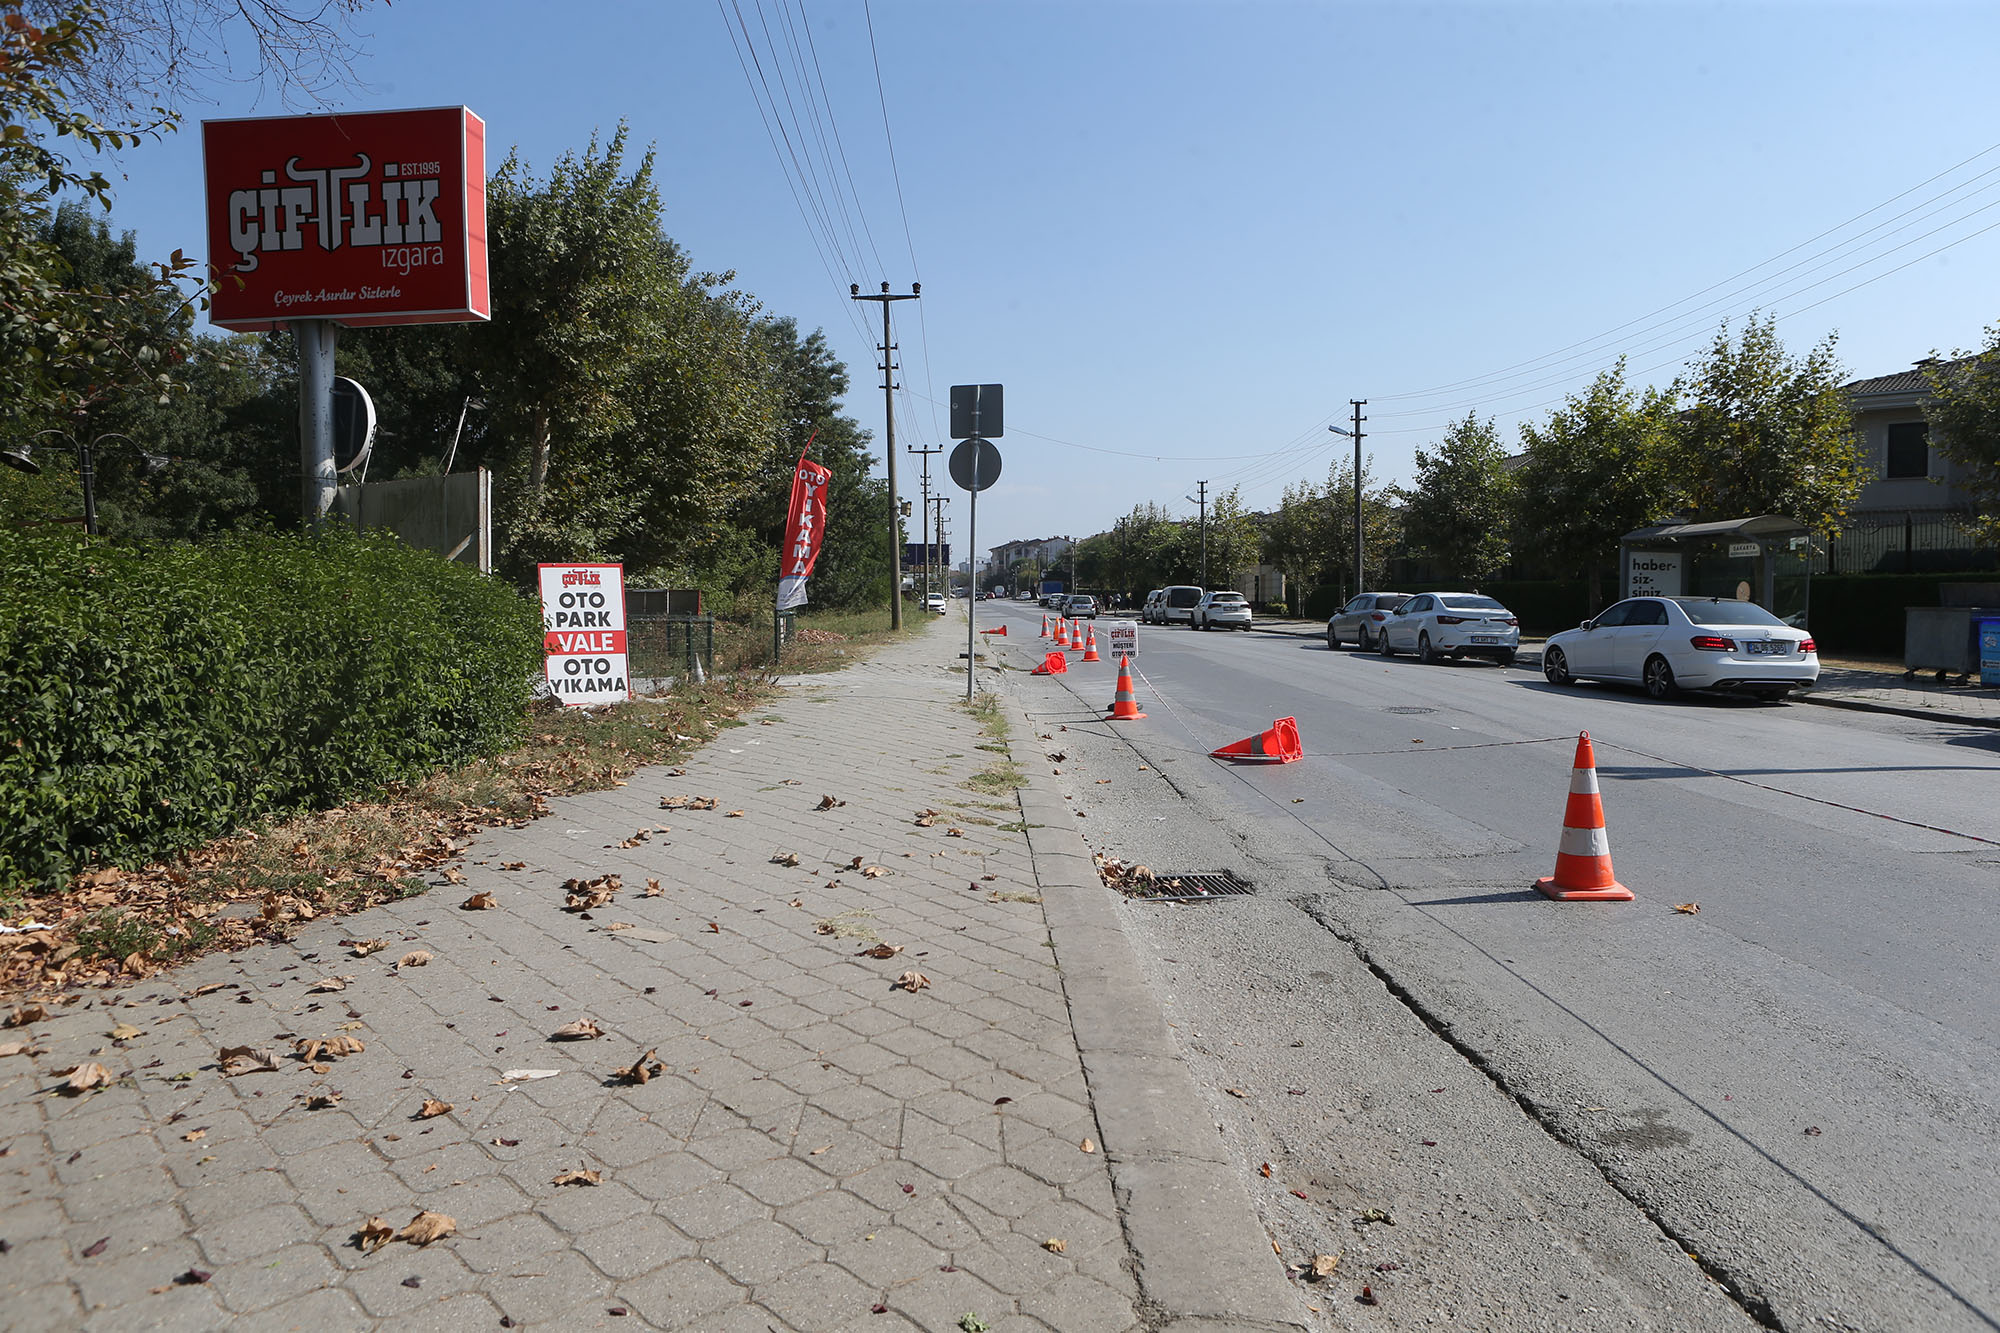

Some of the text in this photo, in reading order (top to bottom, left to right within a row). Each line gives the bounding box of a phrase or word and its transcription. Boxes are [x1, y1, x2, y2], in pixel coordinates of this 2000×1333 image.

[401, 161, 441, 176] EST.1995
[229, 152, 442, 272] ÇİFTLİK
[274, 285, 401, 307] Çeyrek Asırdır Sizlerle
[799, 469, 826, 486] OTO
[791, 482, 818, 575] YIKAMA
[1632, 558, 1677, 571] haber-
[1632, 572, 1654, 584] siz-
[559, 592, 605, 609] OTO
[1631, 586, 1665, 598] siniz.
[556, 611, 611, 628] PARK
[557, 633, 614, 653] VALE
[563, 658, 611, 676] OTO
[550, 677, 627, 694] YIKAMA
